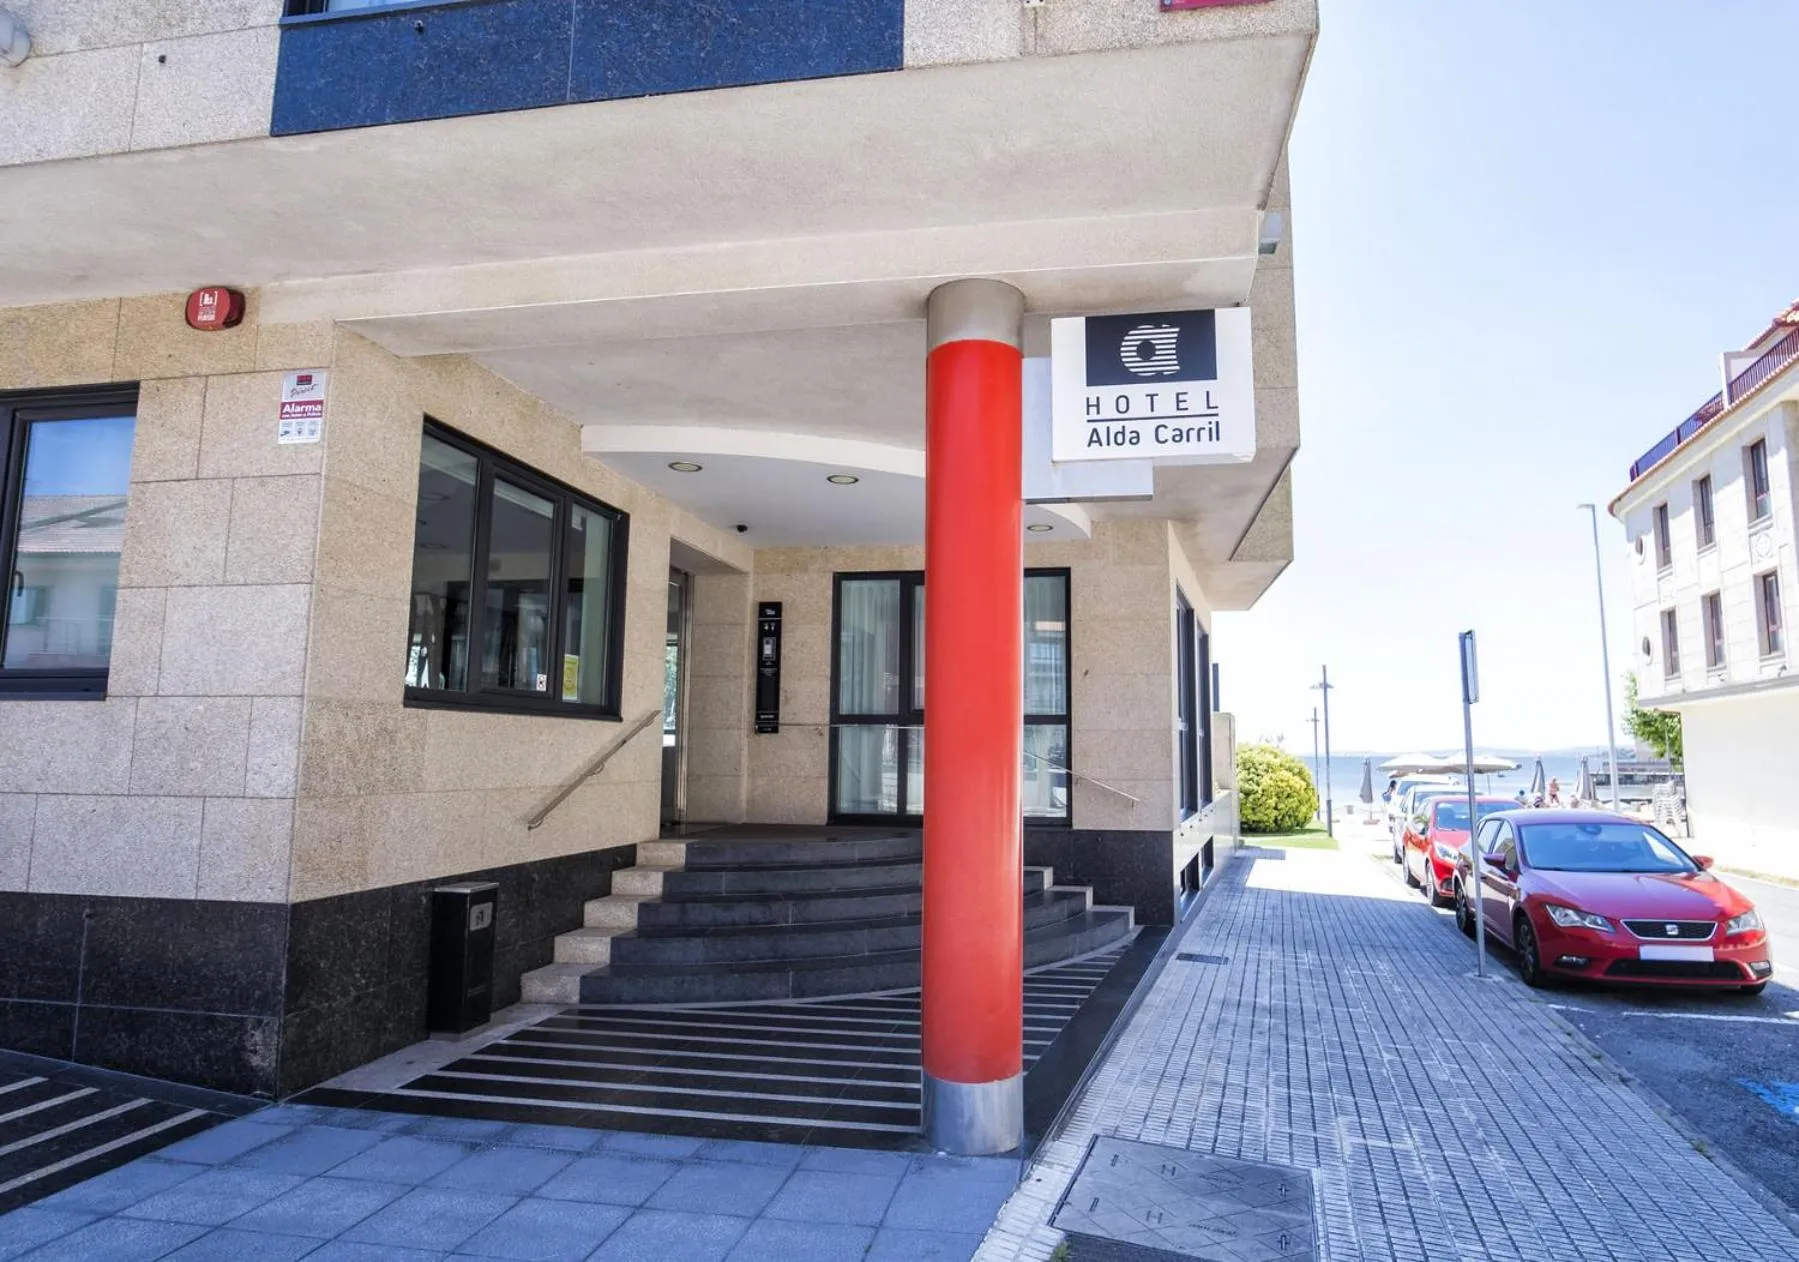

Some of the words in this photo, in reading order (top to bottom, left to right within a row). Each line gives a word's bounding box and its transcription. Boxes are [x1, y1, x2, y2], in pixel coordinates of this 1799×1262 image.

[282, 402, 321, 413] Alarma
[1086, 391, 1219, 416] HOTEL
[1087, 425, 1140, 448] Alda
[1154, 421, 1220, 445] Carril
